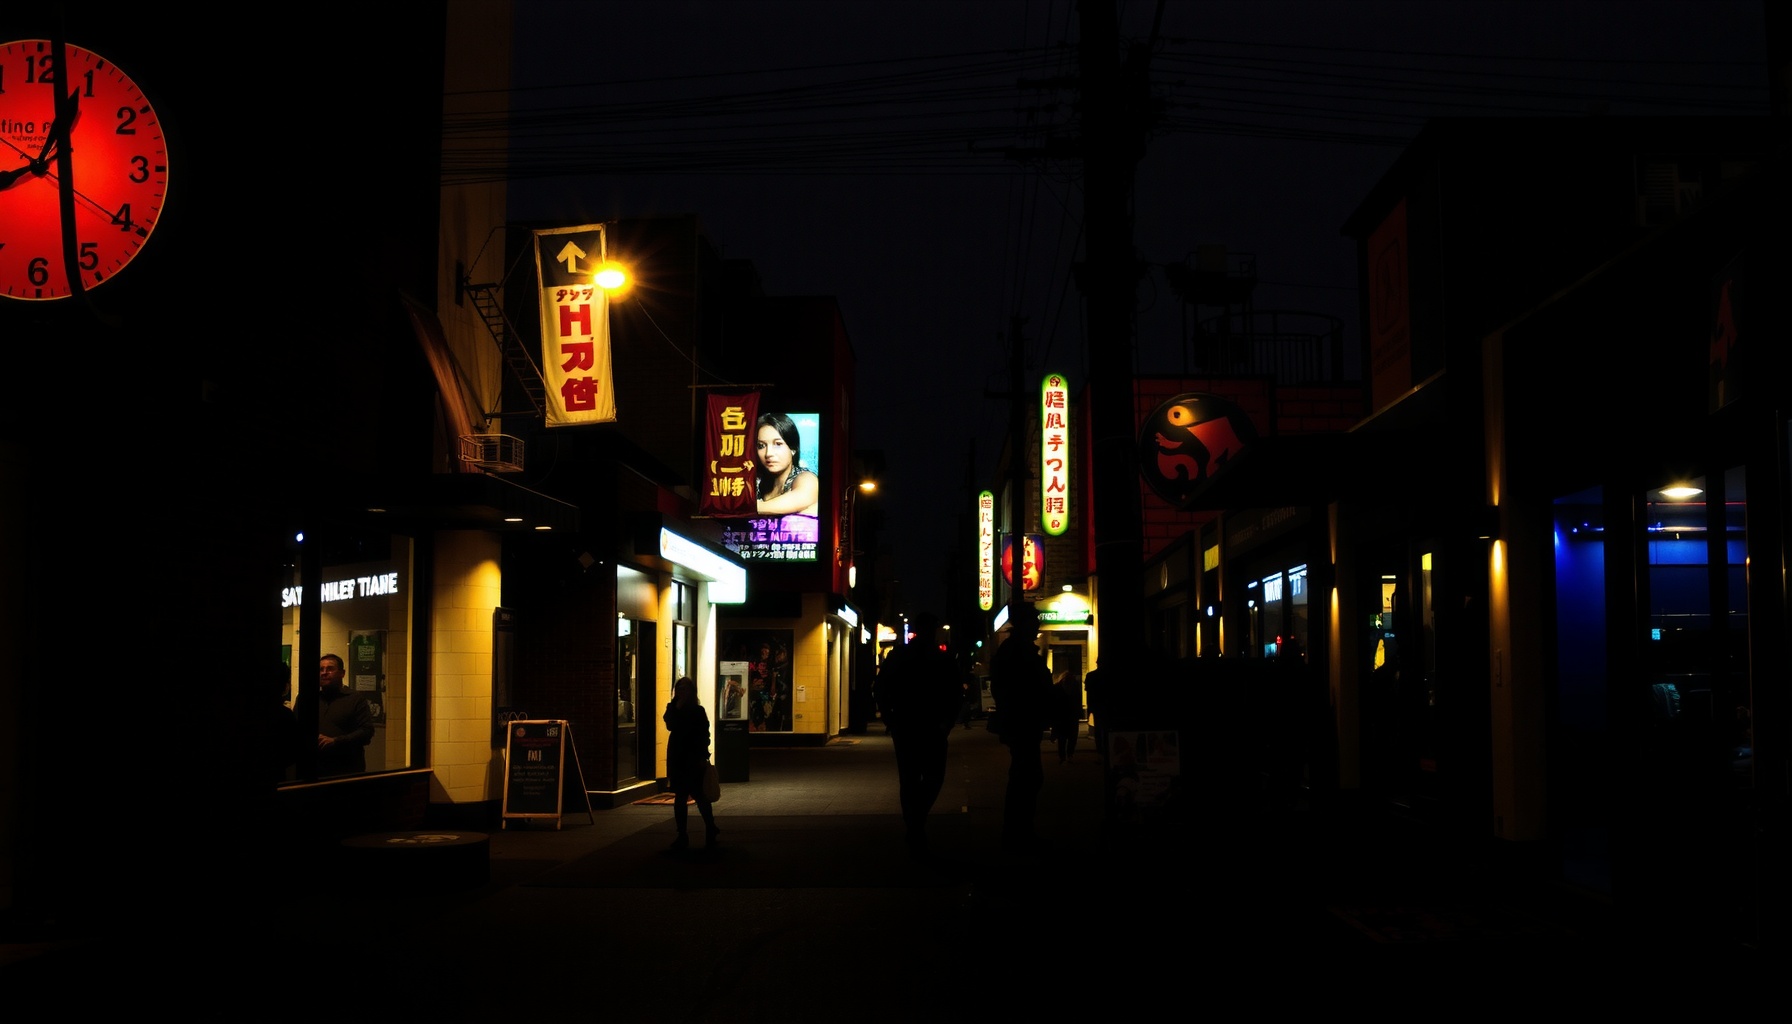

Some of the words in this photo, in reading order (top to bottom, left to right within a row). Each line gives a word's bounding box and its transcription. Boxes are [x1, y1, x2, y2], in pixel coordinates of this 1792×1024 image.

[25, 55, 54, 83] 12
[83, 69, 95, 97] 1
[116, 106, 137, 135] 2
[128, 156, 150, 183] 3
[111, 203, 133, 232] 4
[79, 242, 99, 271] 5
[27, 257, 49, 286] 6
